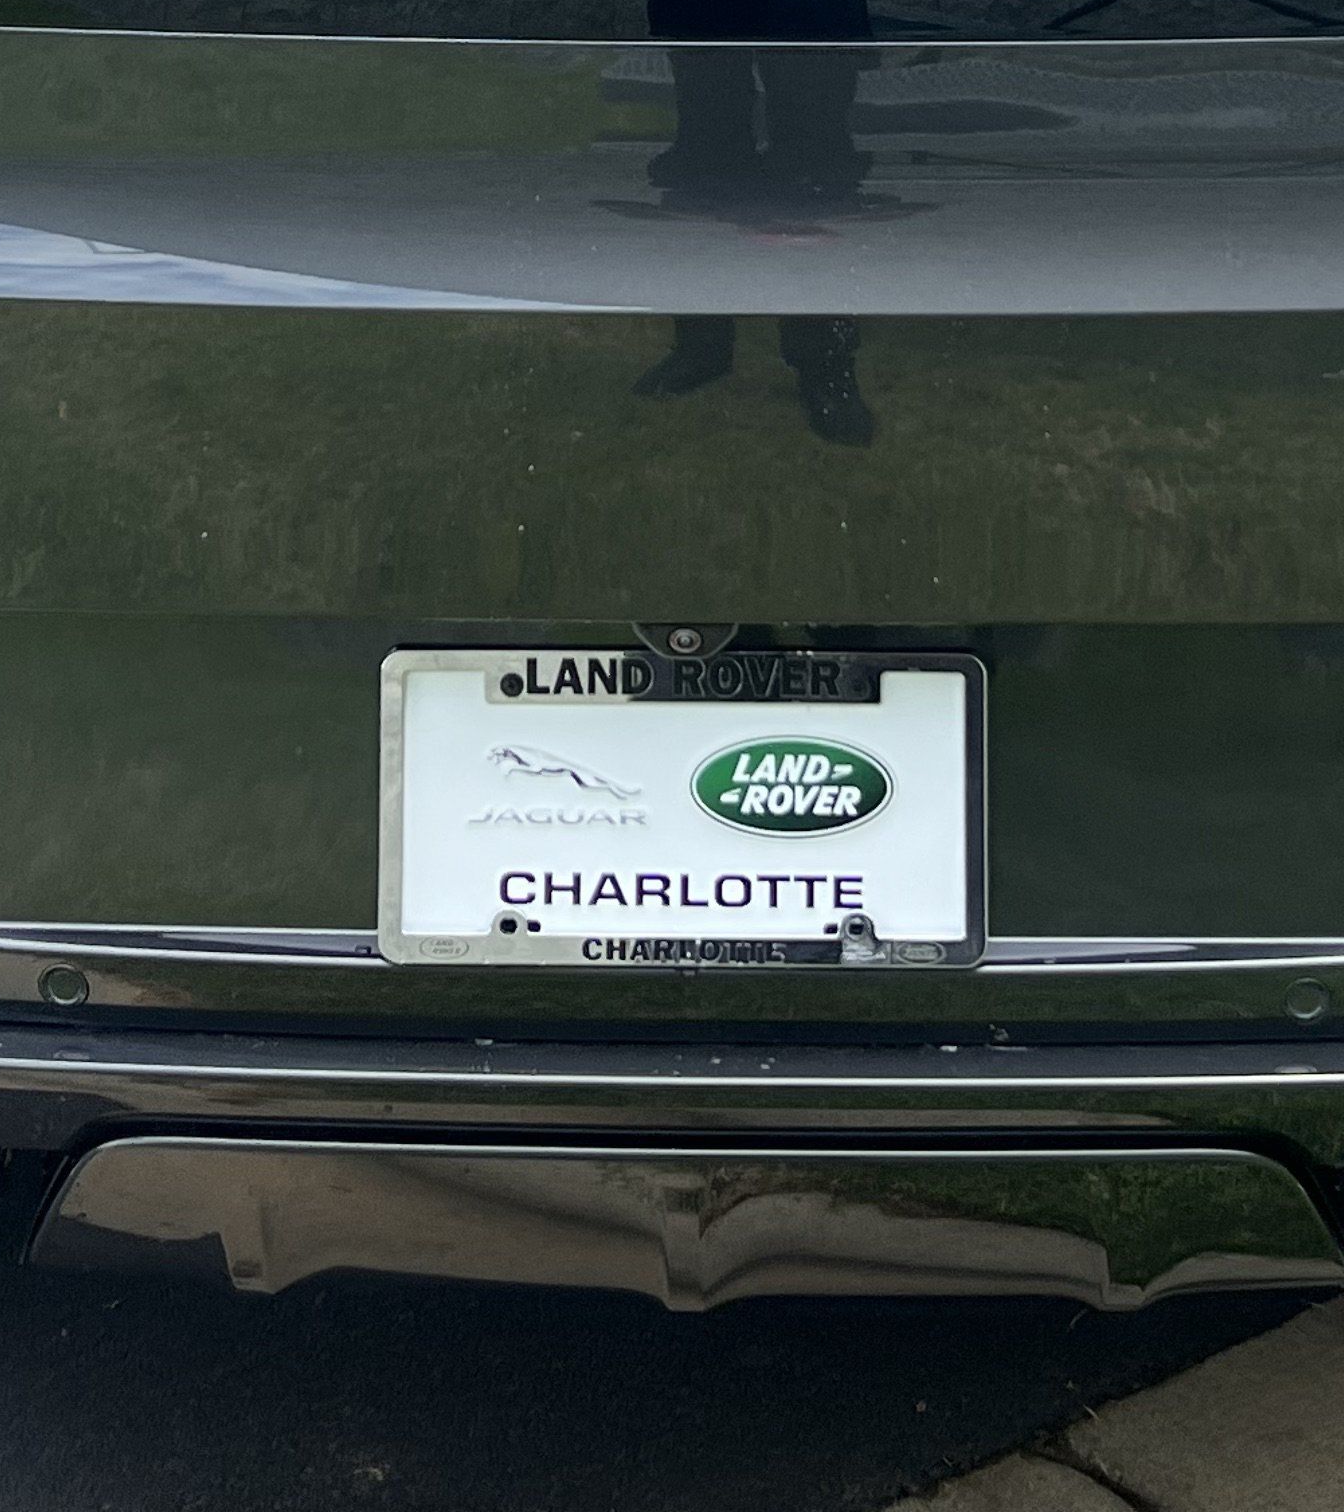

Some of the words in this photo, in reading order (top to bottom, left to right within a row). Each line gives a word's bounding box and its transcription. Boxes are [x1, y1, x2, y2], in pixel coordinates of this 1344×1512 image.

[525, 656, 655, 696] LAND
[672, 656, 843, 698] ROVER
[467, 807, 647, 827] JAGUAR
[739, 785, 864, 817] ROVER
[498, 870, 865, 910] CHARLOTTE
[581, 937, 788, 964] CHARLOTTE
